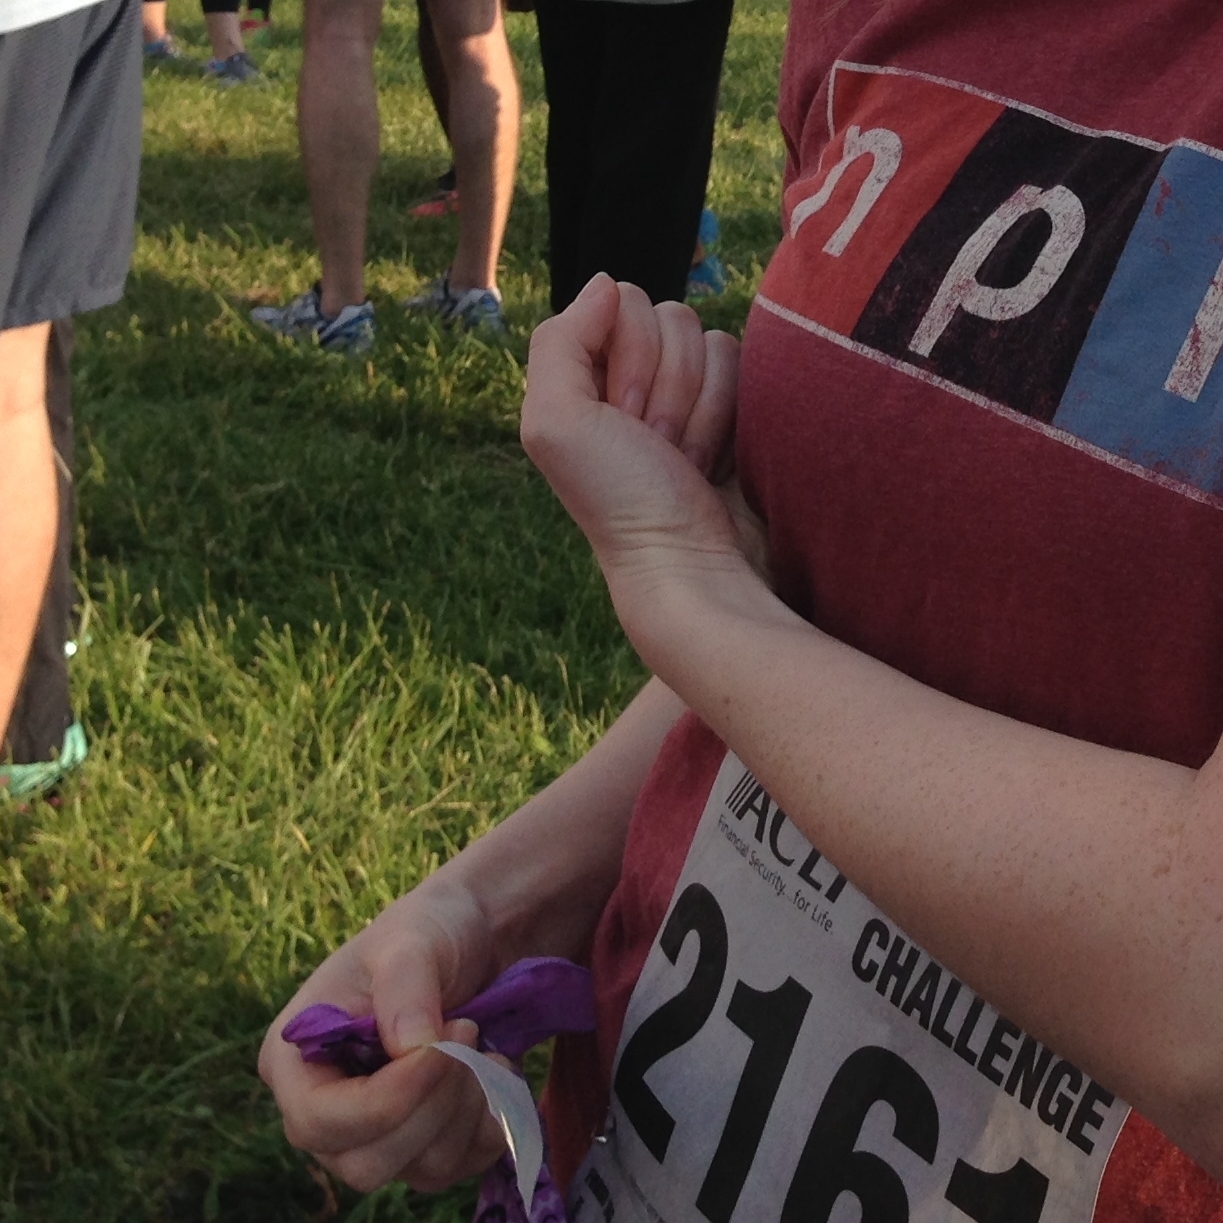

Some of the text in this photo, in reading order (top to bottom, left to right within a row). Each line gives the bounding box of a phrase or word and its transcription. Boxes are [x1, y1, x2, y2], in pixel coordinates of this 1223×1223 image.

[717, 813, 750, 858] Financial
[613, 882, 1050, 1223] 216
[852, 918, 1116, 1157] CHALLENGE
